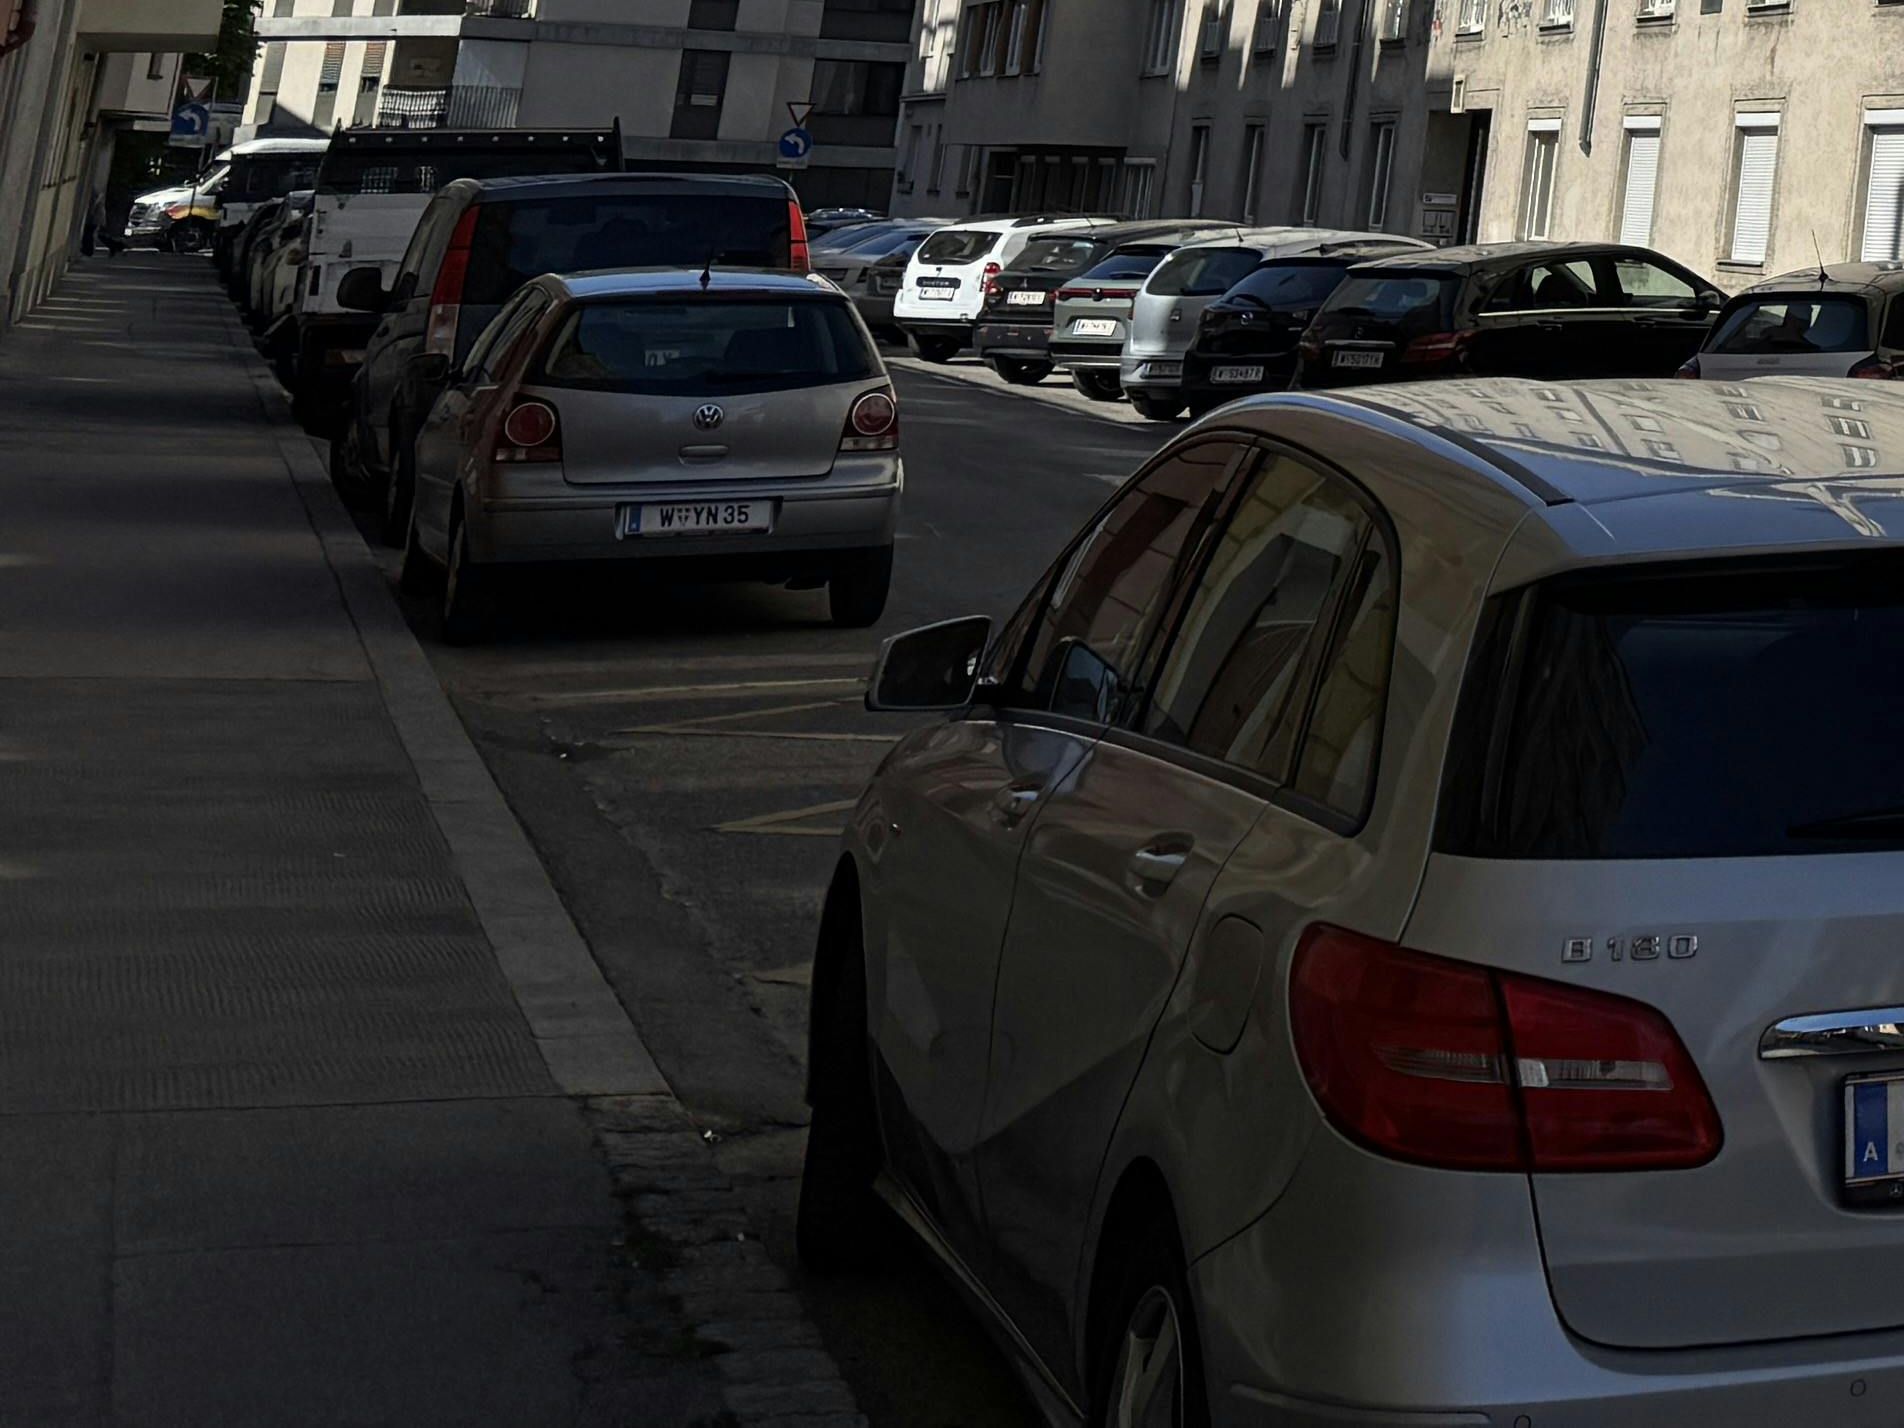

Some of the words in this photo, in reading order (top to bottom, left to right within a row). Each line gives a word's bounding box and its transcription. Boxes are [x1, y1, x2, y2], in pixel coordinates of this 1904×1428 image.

[660, 507, 675, 527] W
[693, 506, 719, 526] YN
[724, 505, 749, 524] 35
[1562, 936, 1593, 964] B
[1863, 1141, 1879, 1162] A
